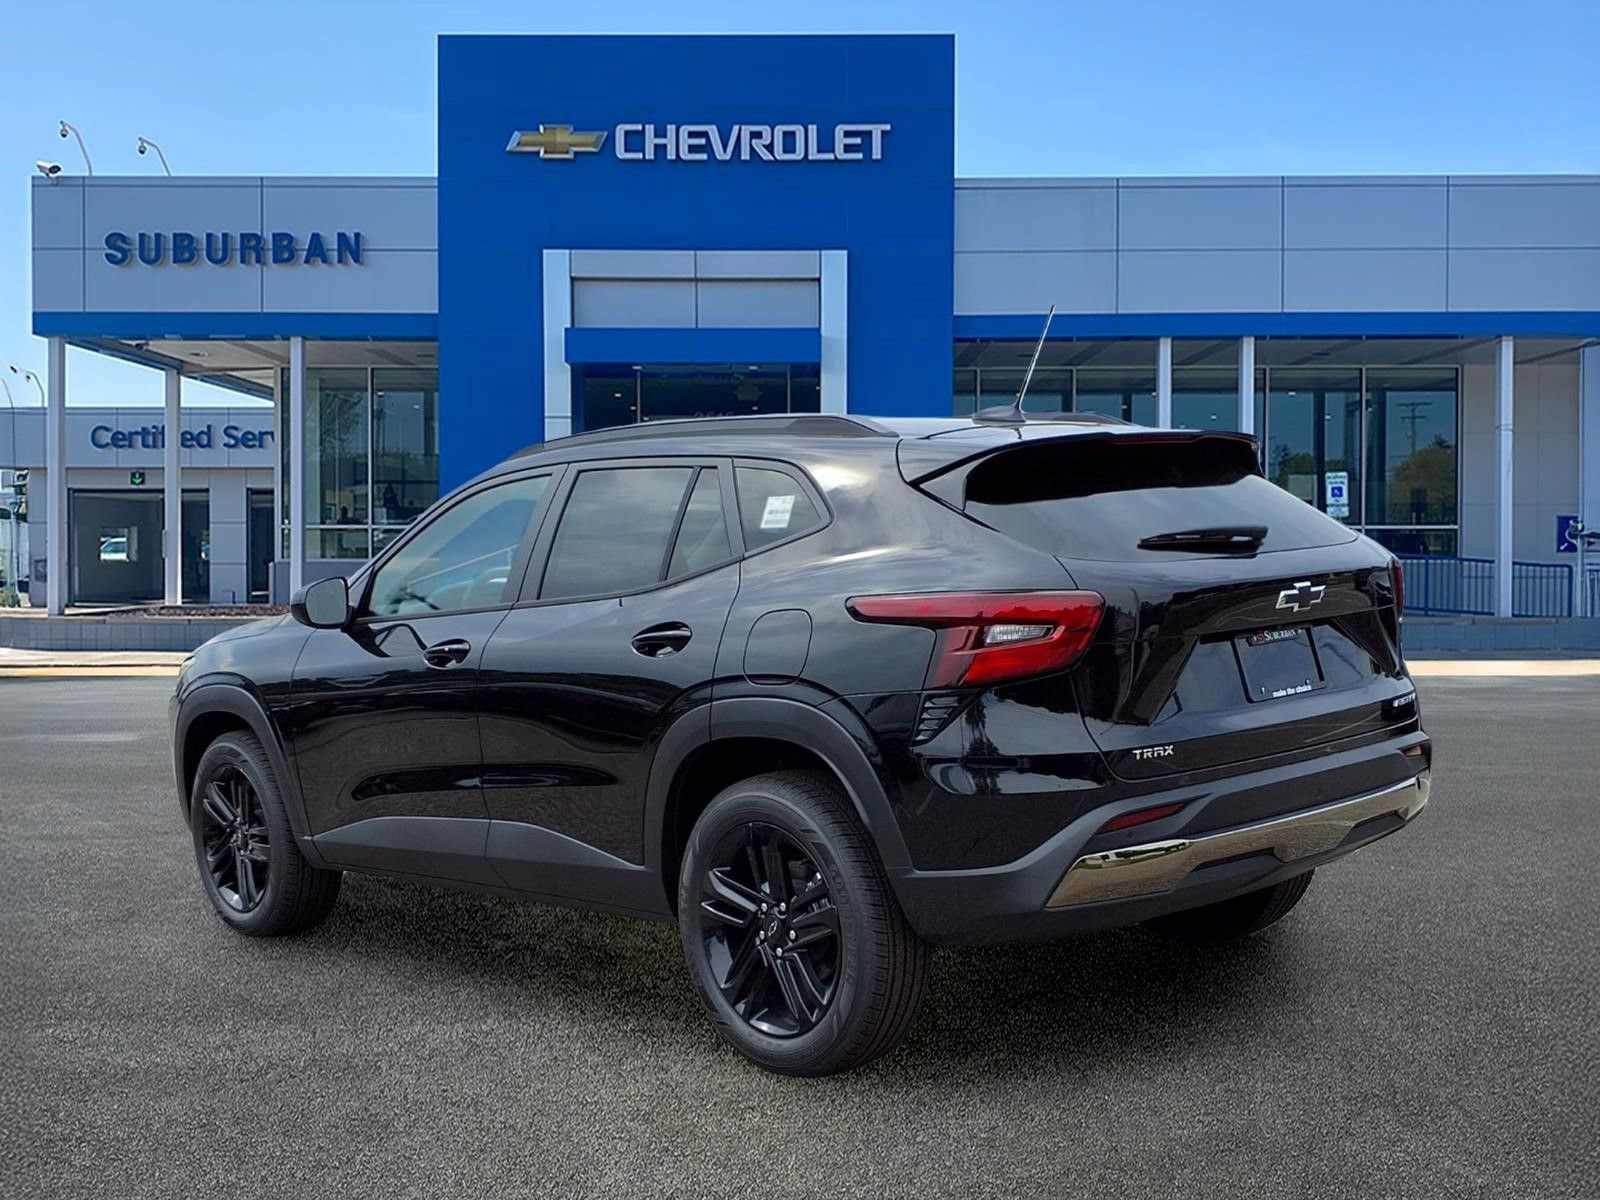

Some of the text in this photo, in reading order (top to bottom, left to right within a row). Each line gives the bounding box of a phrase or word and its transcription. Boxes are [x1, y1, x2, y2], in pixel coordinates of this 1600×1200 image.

[615, 123, 892, 161] CHEVROLET
[104, 231, 363, 266] SUBURBAN
[91, 424, 212, 450] Certifed
[1132, 745, 1174, 760] TRAX
